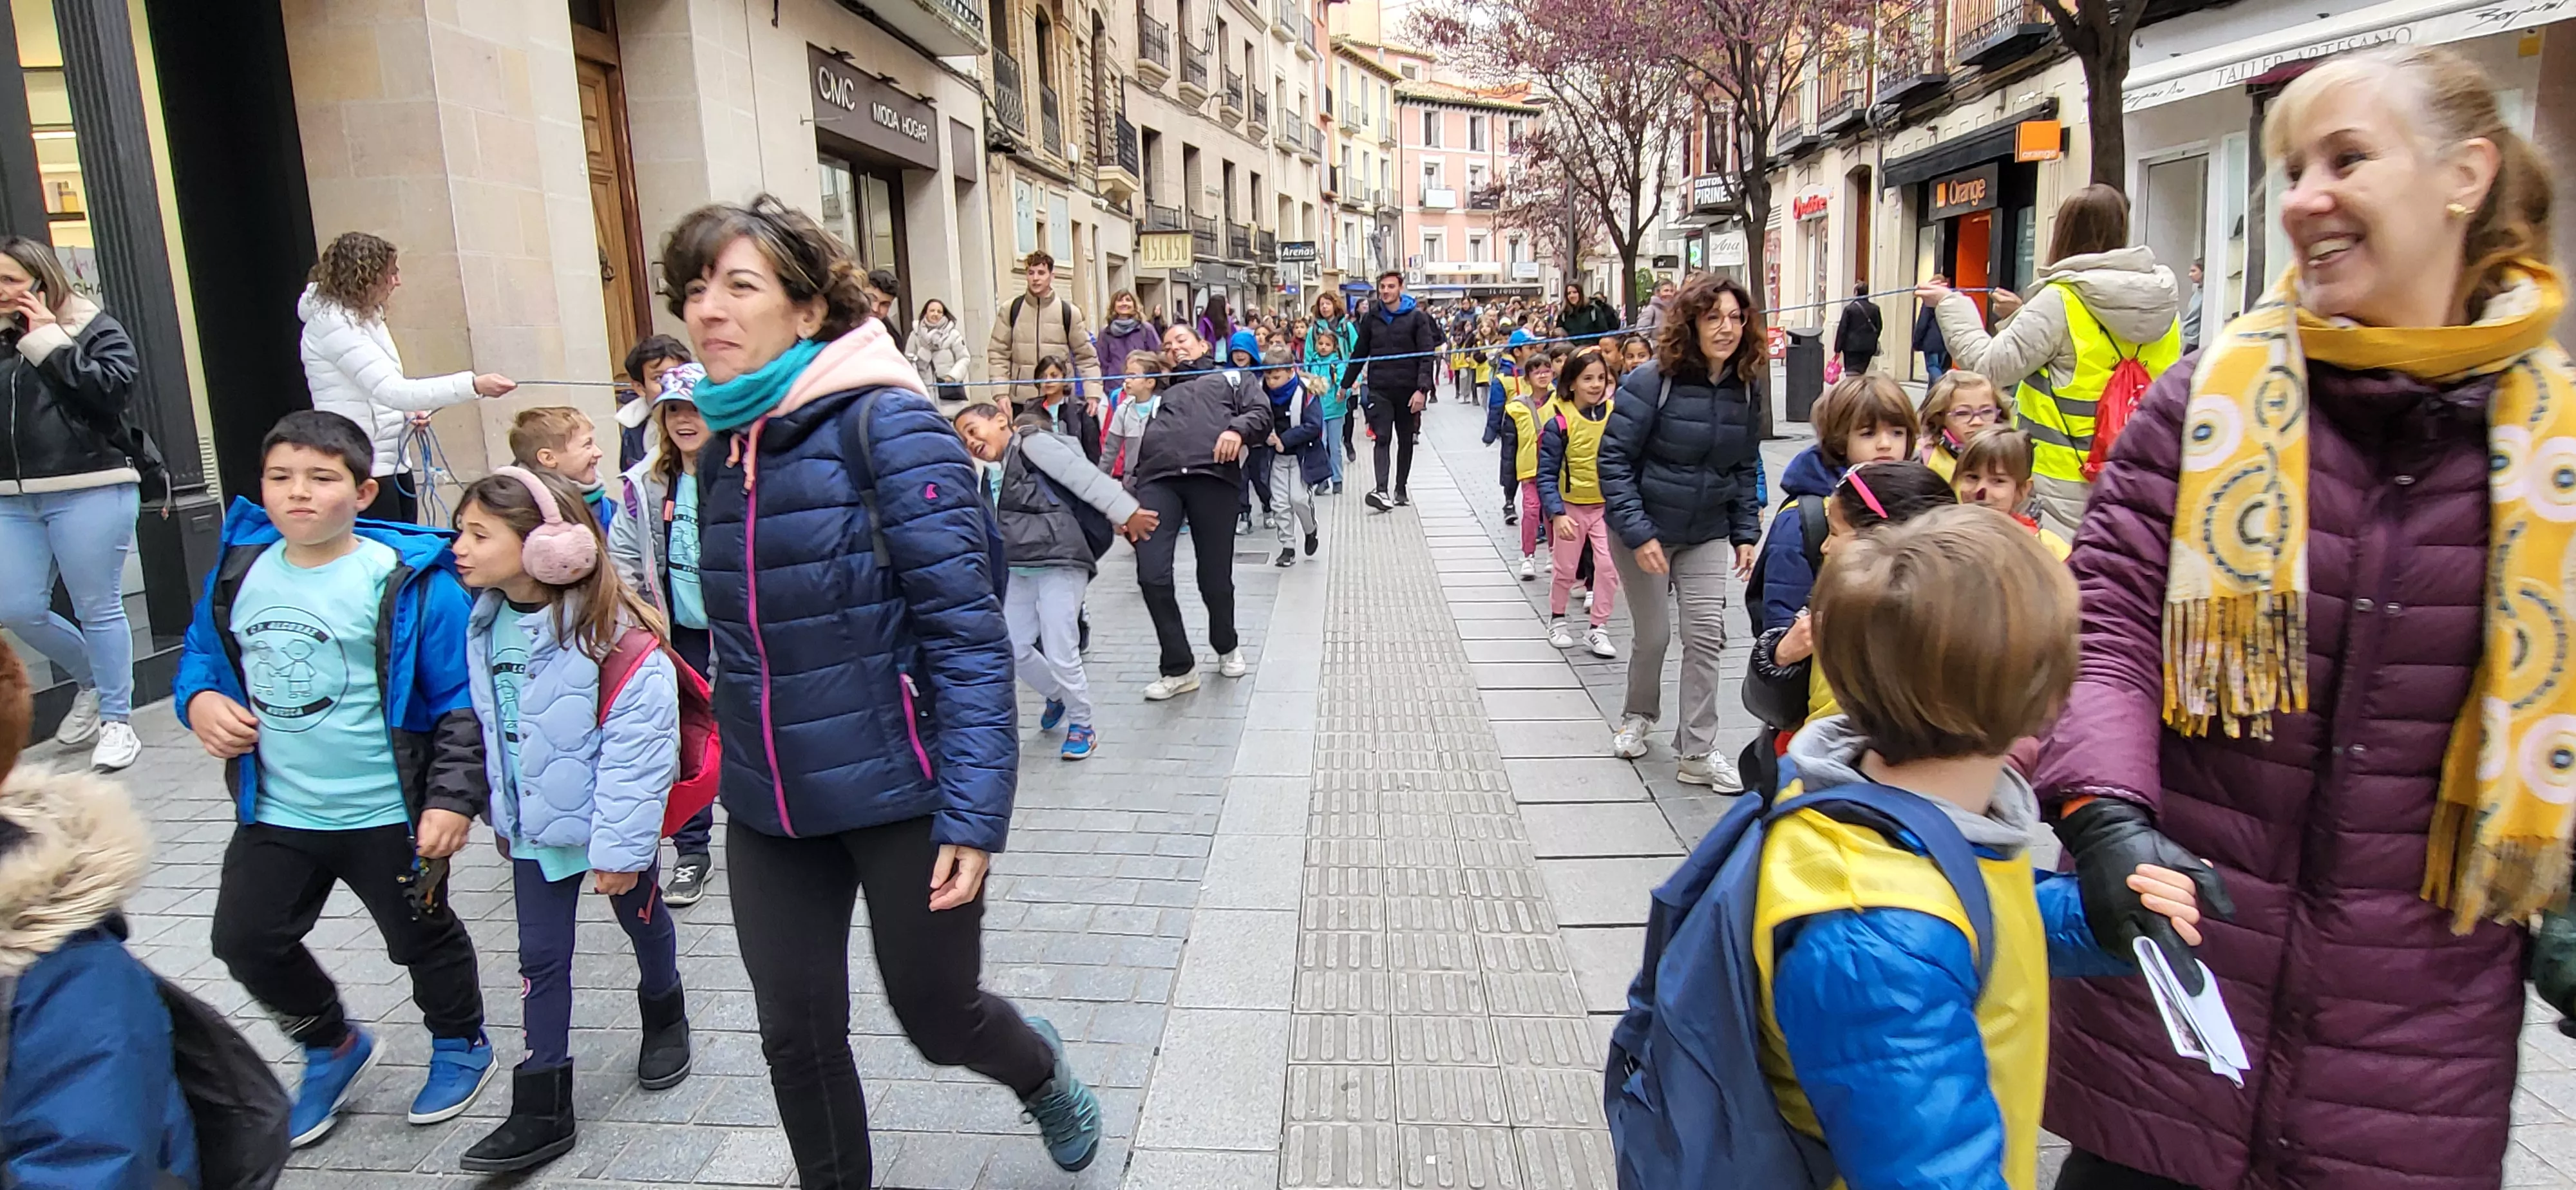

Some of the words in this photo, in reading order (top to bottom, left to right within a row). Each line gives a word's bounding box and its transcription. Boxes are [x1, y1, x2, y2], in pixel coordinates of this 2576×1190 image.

[819, 66, 855, 111] CMC
[873, 101, 900, 132] MODA
[902, 115, 929, 143] HOGAR
[2022, 149, 2057, 160] orange
[1949, 178, 1986, 207] Orange
[1282, 247, 1314, 257] Arenas
